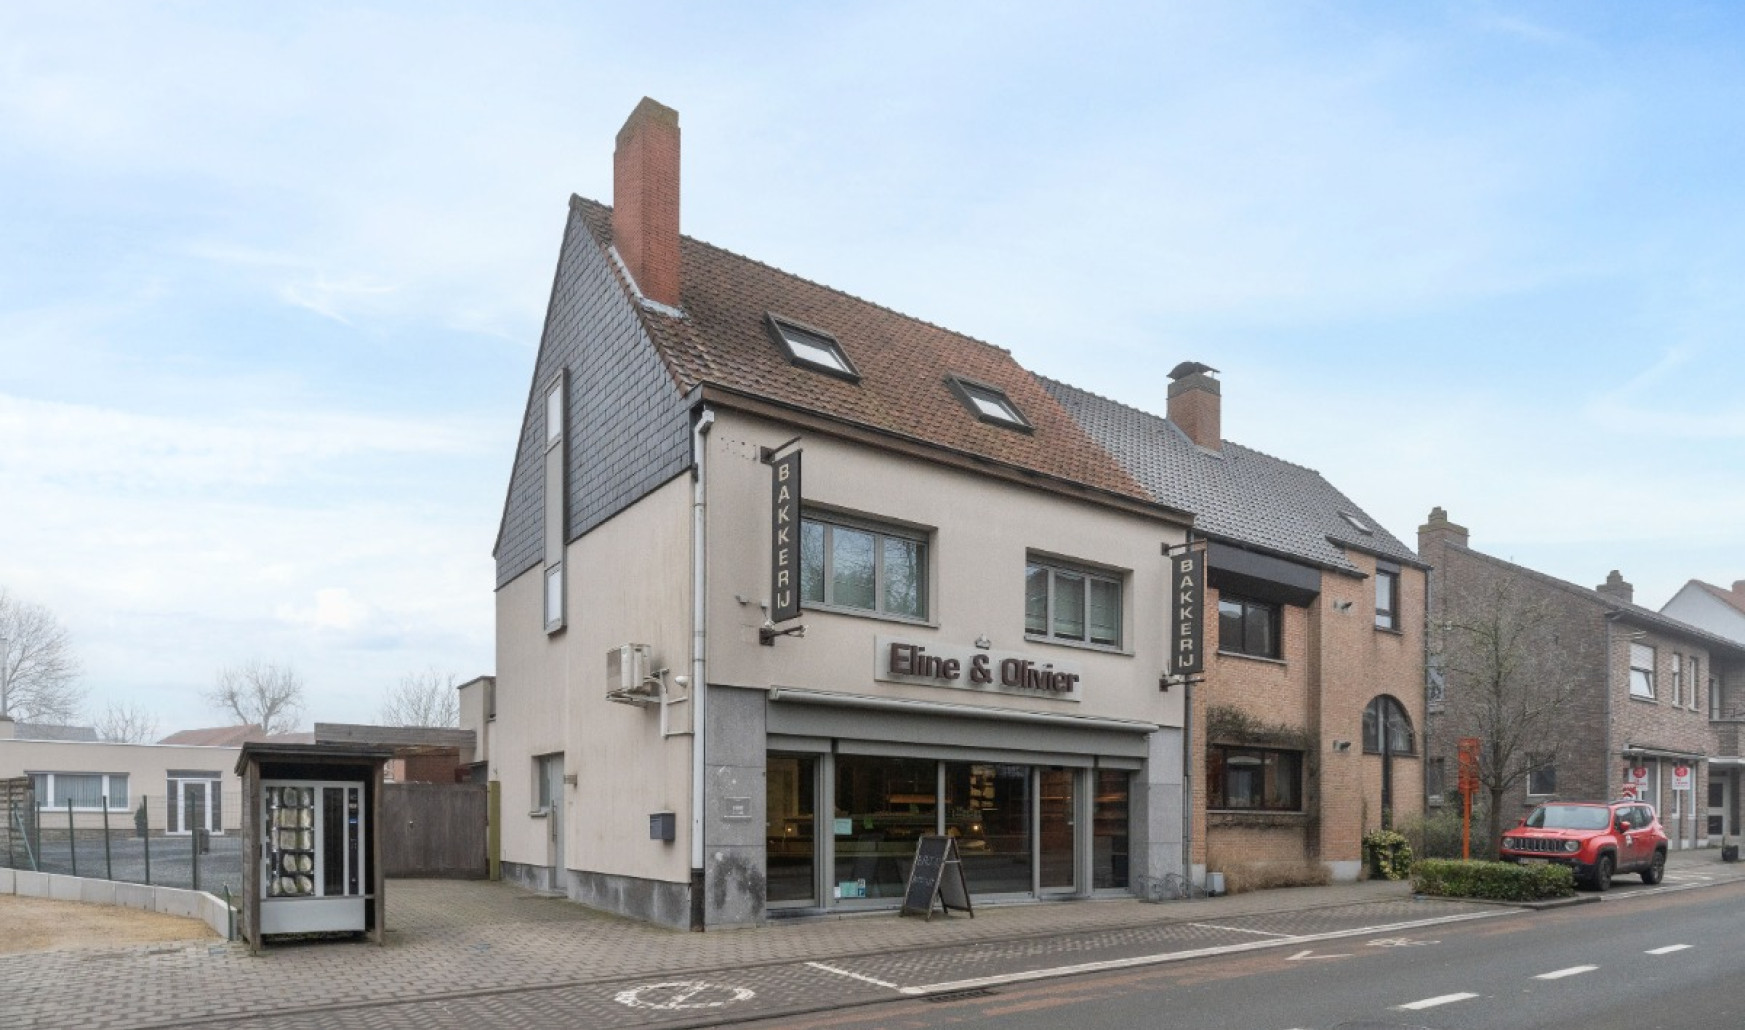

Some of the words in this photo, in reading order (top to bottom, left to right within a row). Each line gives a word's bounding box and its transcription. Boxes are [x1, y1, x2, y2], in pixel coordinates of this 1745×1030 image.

[777, 463, 791, 609] BAKKERIJ
[889, 642, 961, 680] Eline
[969, 653, 993, 684] &
[1000, 657, 1080, 693] Olivier
[1178, 559, 1195, 668] BAKKERIJ
